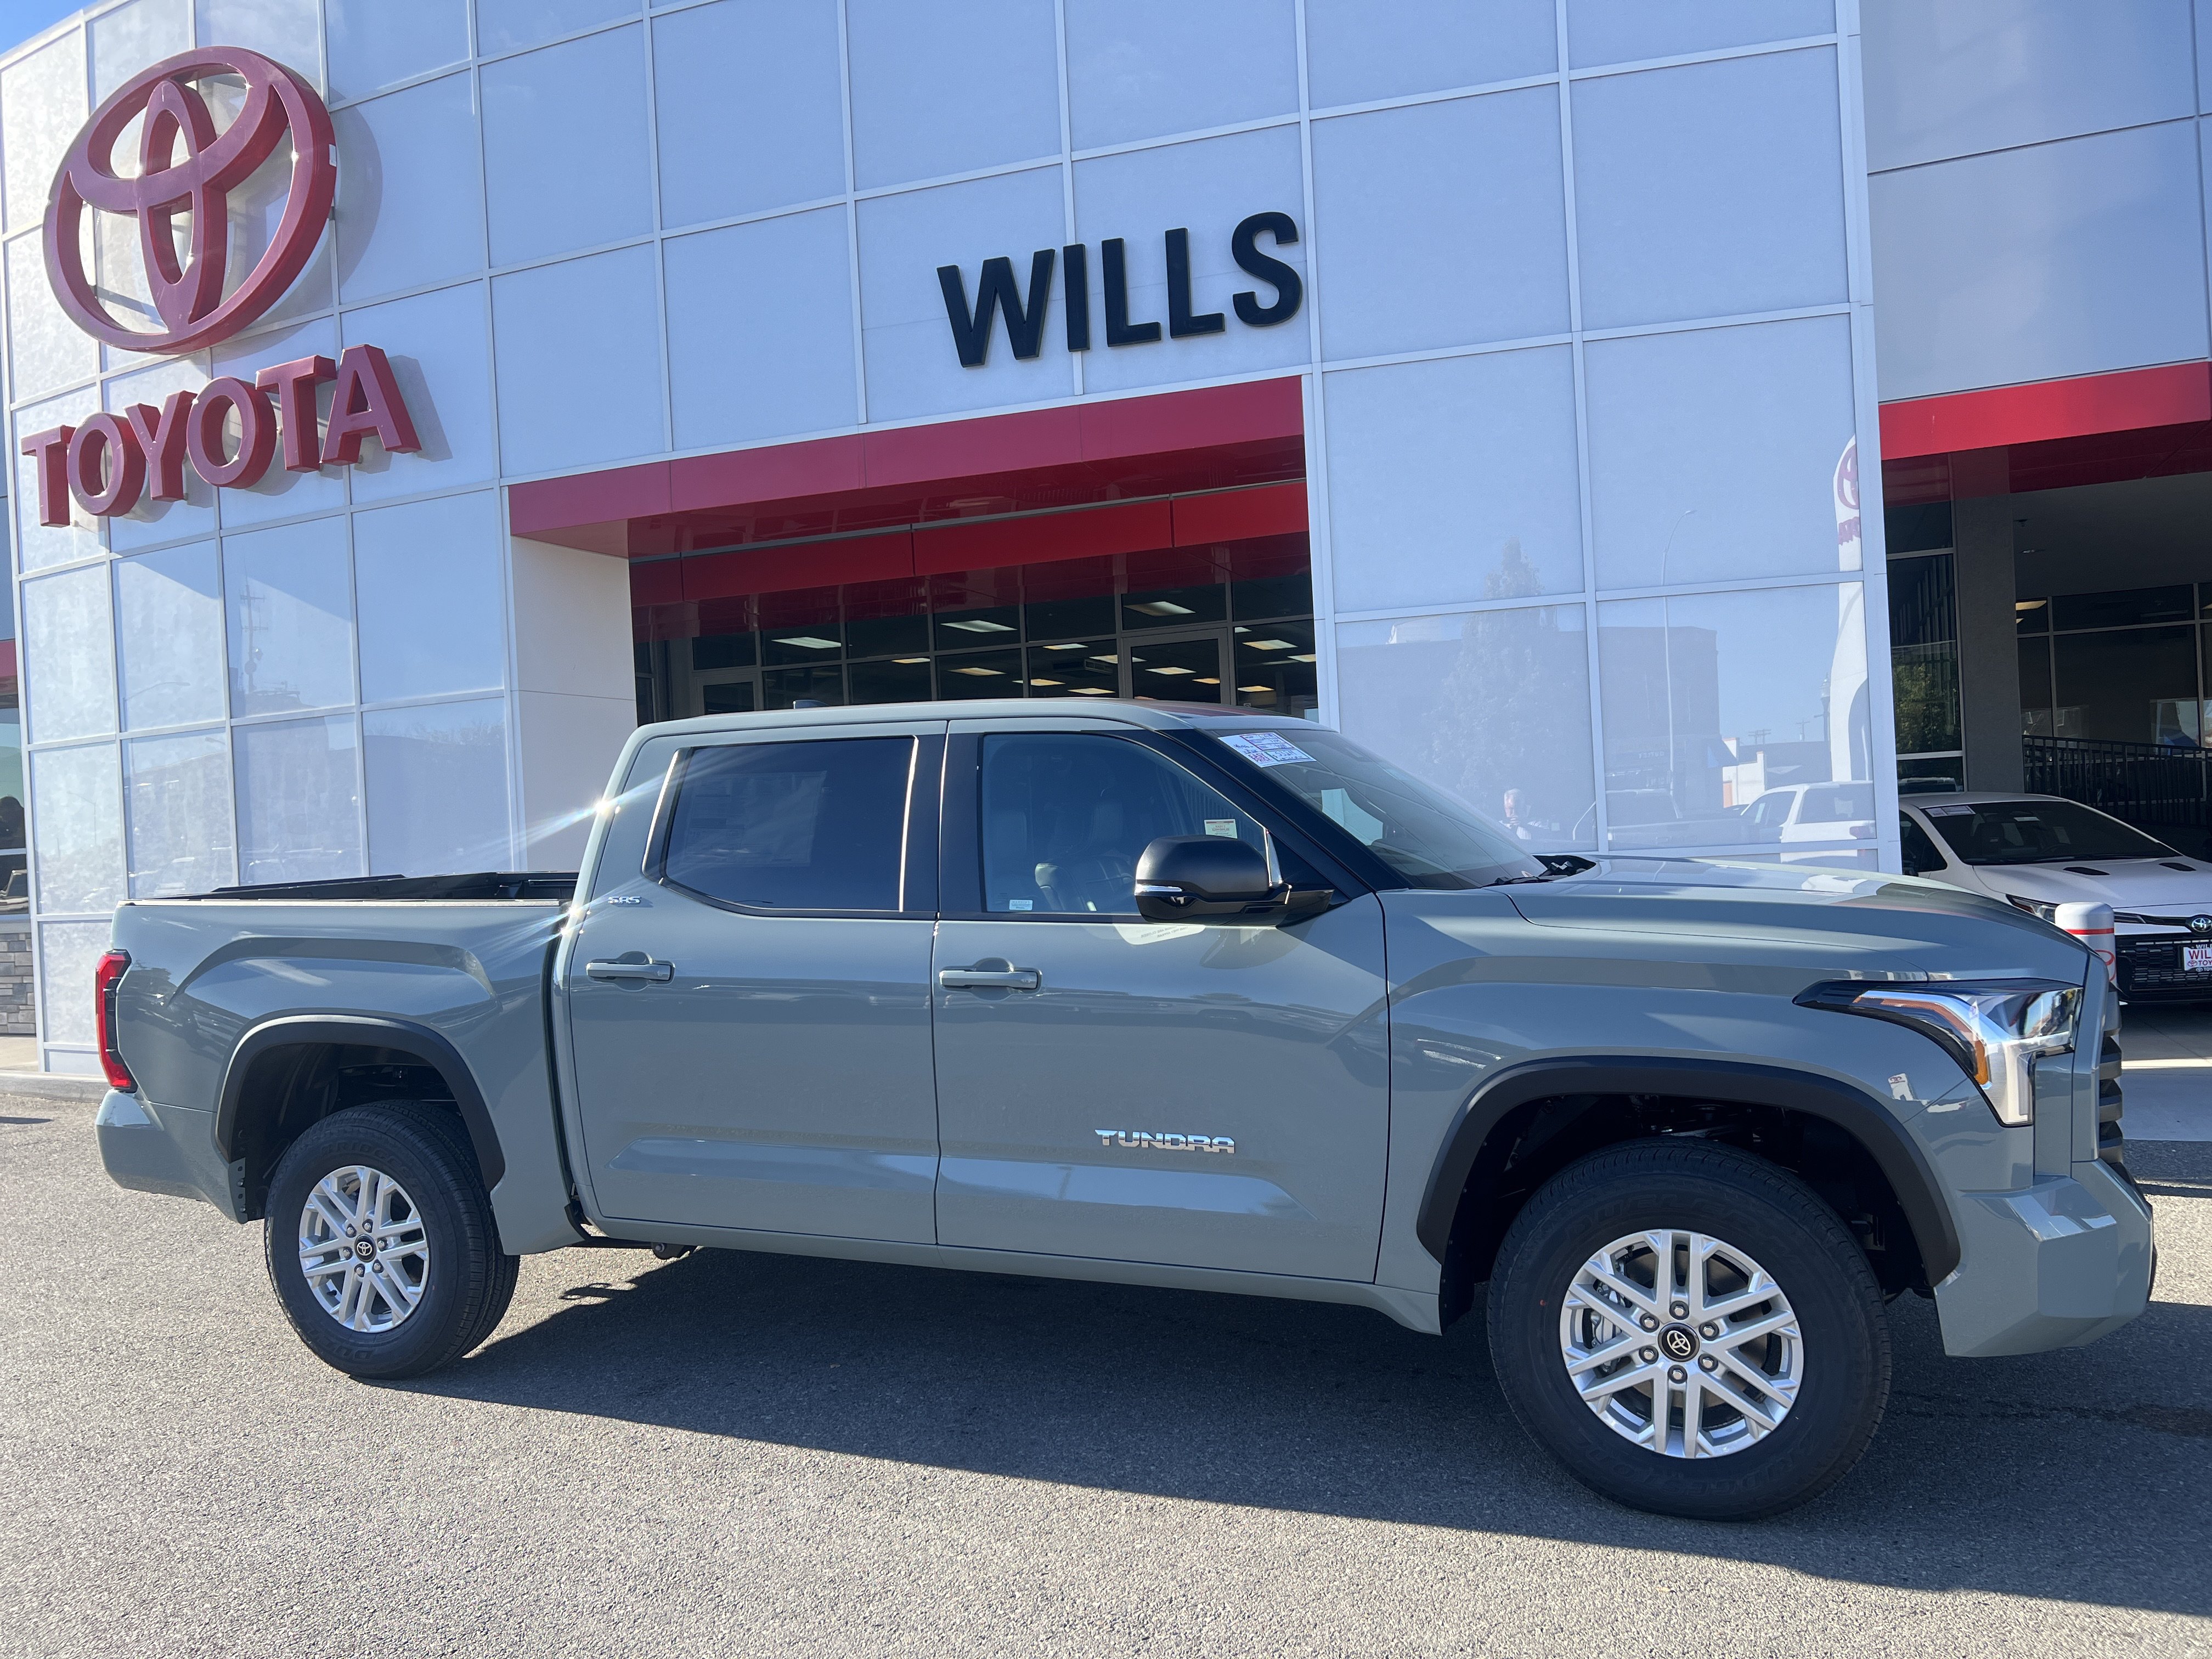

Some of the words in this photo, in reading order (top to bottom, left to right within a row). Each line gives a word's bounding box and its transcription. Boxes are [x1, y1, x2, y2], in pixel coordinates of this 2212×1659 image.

[937, 212, 1303, 368] WILLS
[21, 343, 422, 528] TOYOTA
[2188, 950, 2212, 960] WIL
[1094, 1129, 1235, 1154] TUNDRA
